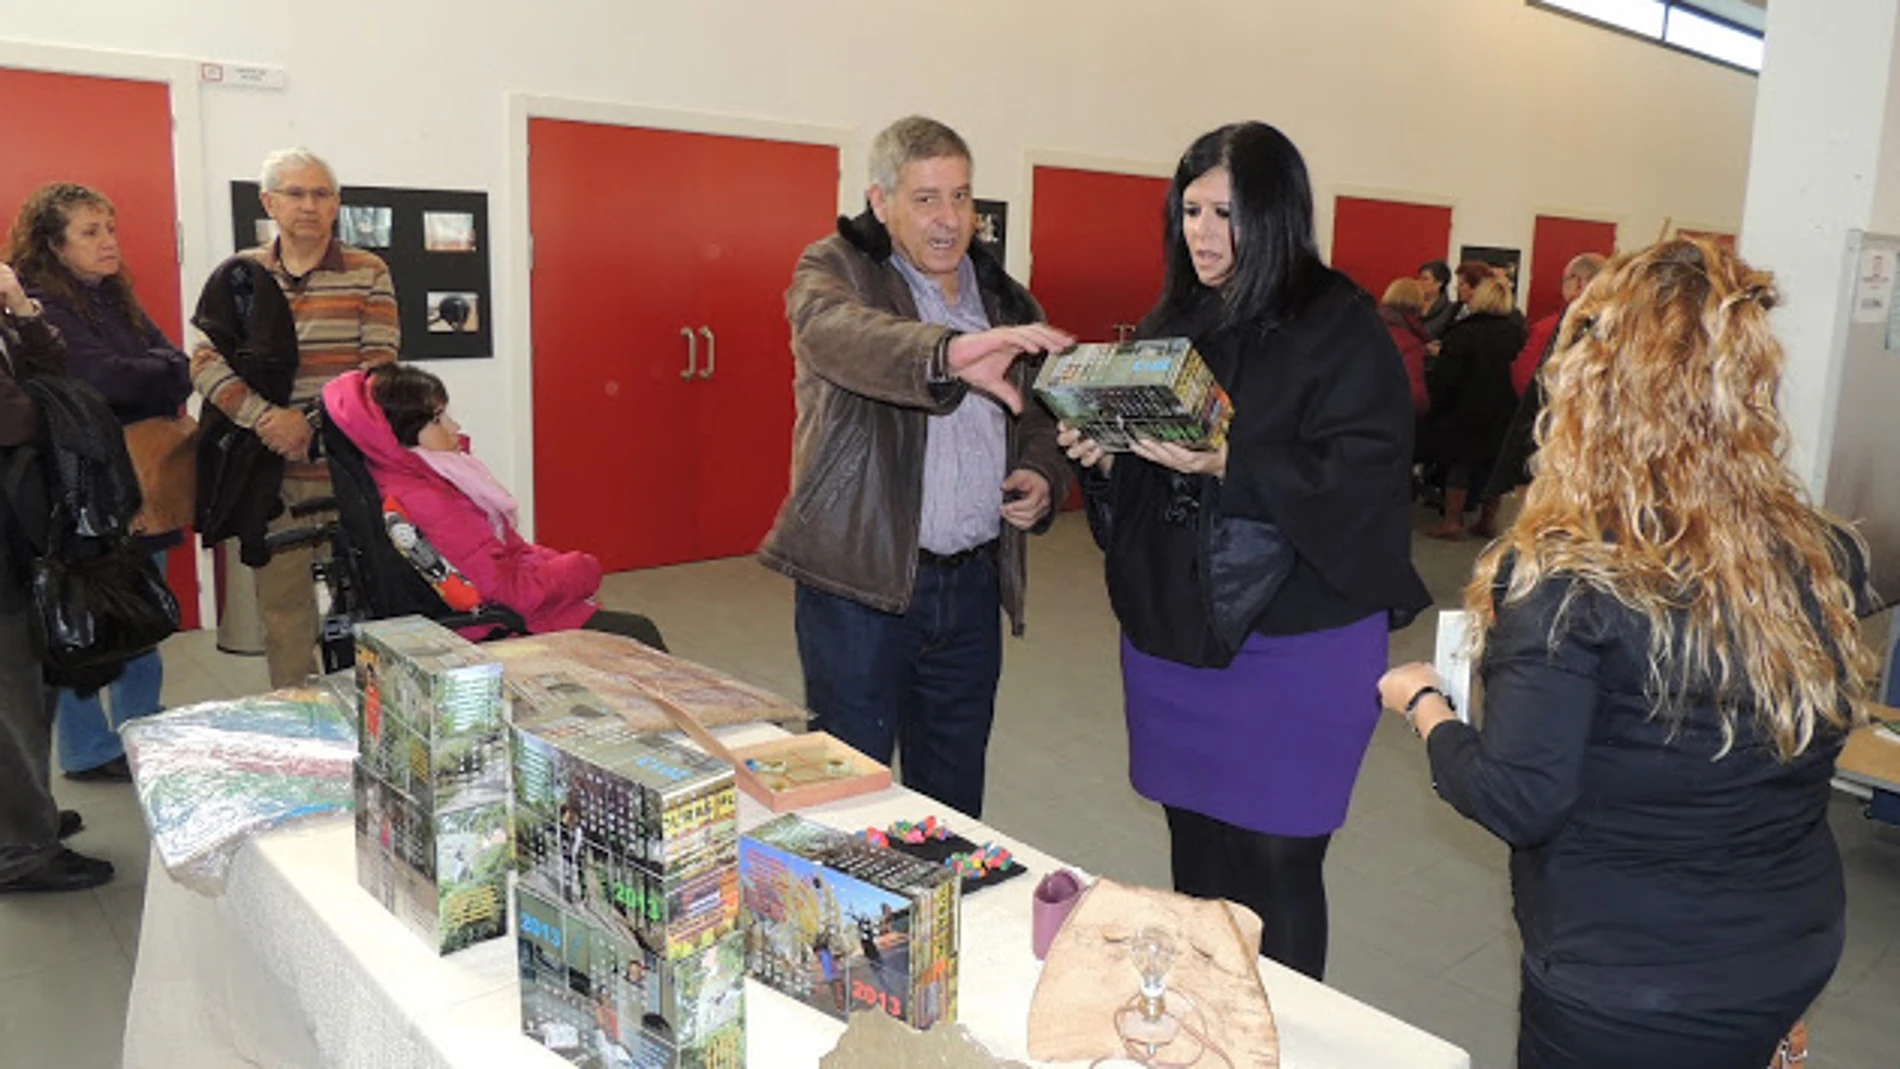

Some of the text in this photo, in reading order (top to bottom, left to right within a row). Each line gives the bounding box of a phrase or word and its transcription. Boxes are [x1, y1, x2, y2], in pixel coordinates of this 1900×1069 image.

[613, 881, 663, 922] 2013
[520, 912, 562, 948] 2013
[850, 979, 903, 1017] 2013
